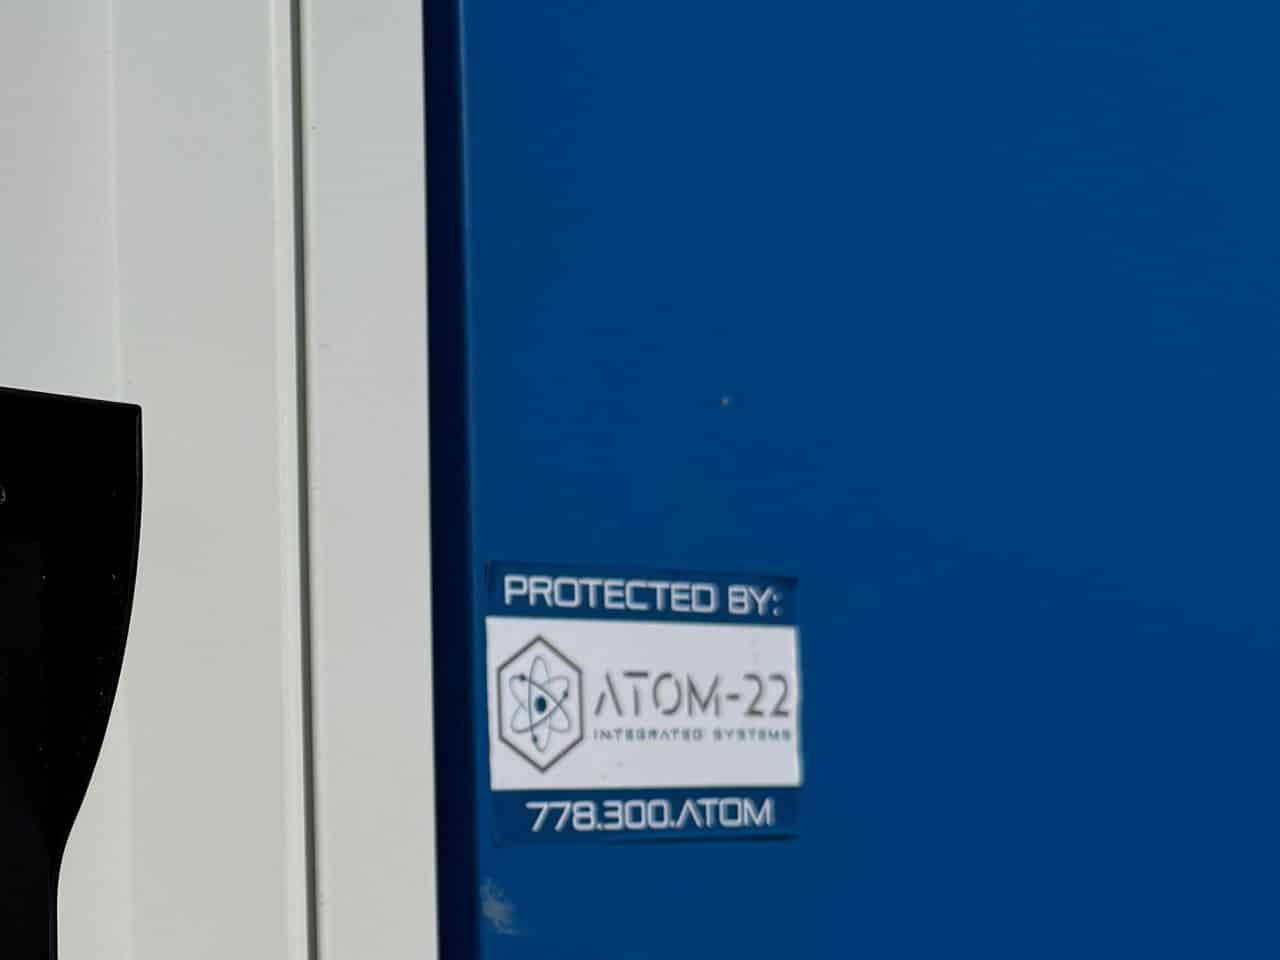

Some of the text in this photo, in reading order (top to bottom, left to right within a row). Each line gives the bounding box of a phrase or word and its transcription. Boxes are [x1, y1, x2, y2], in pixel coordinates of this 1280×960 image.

[504, 575, 783, 616] PROTECTED BY:
[594, 671, 789, 717] ATOM-22
[593, 728, 791, 741] INTEGRATED SYSTEMS
[526, 798, 775, 832] 778.300.ATOM
